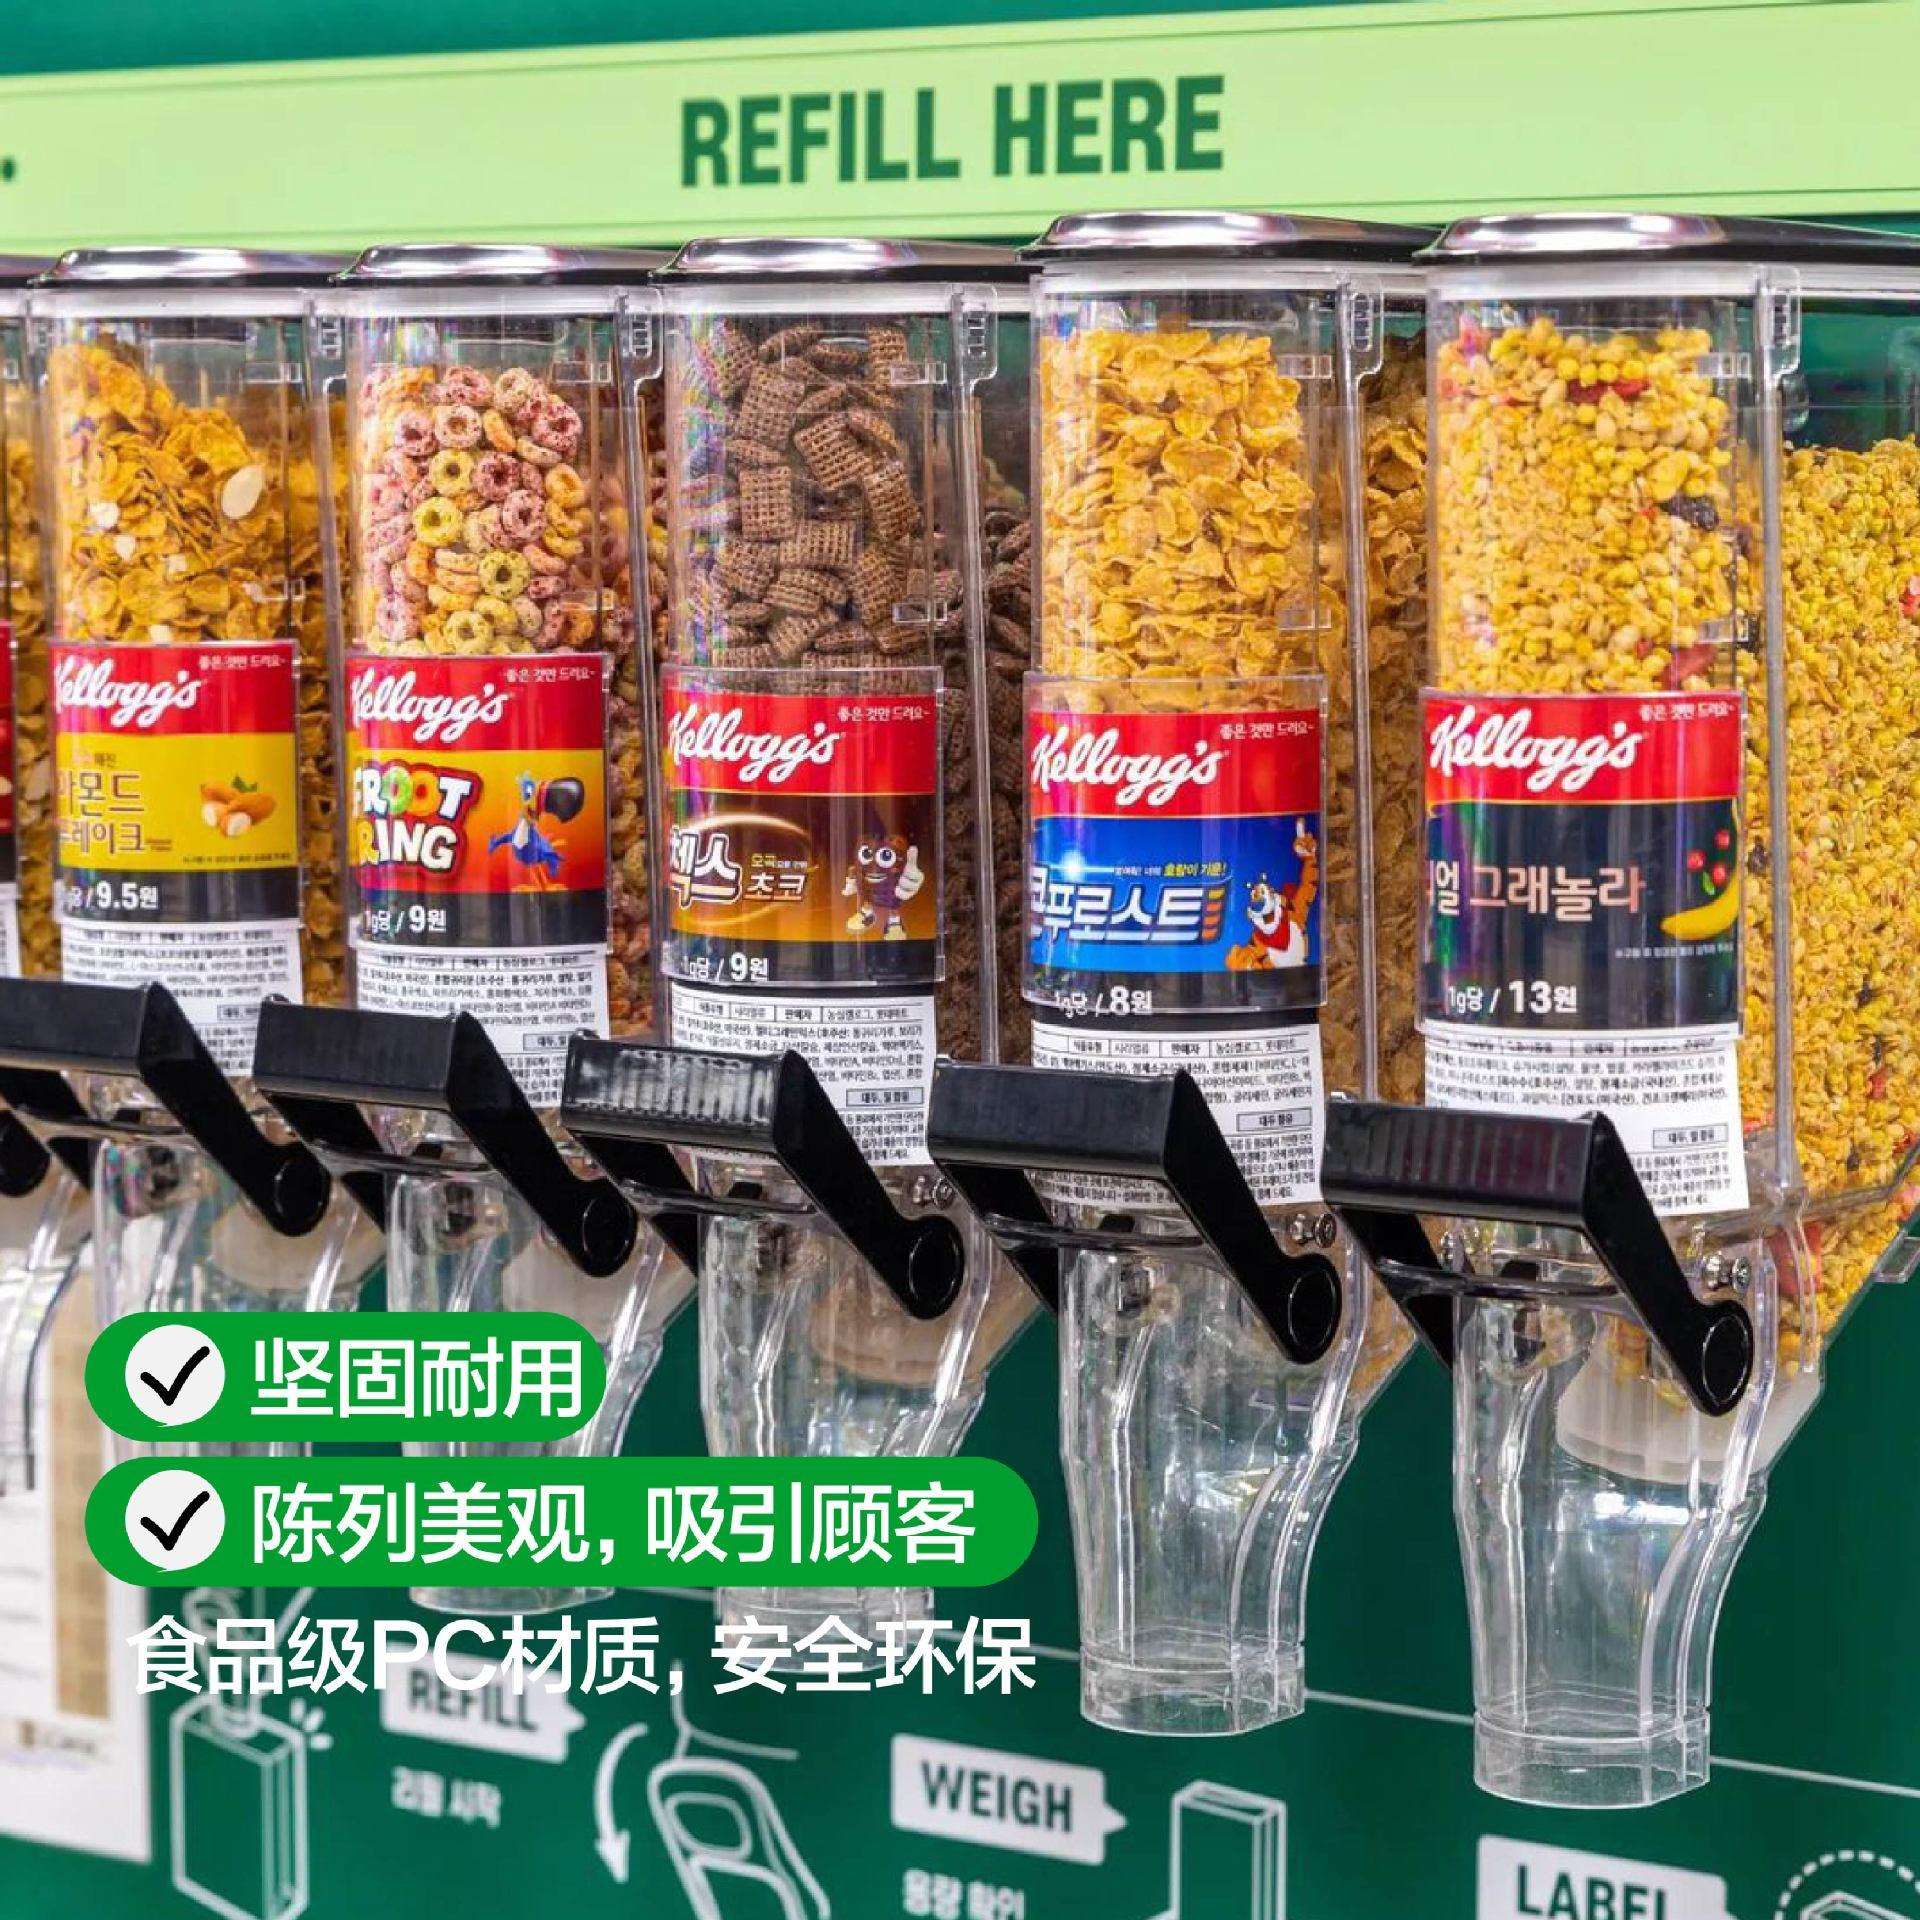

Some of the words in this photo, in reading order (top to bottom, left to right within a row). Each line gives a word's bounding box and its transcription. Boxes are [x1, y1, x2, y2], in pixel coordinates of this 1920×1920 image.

[682, 88, 961, 188] REFILL
[994, 76, 1225, 178] HERE
[668, 703, 841, 784] Kellogg's
[1031, 726, 1226, 807] Kellogg's
[1430, 704, 1647, 793] Kellogg's
[357, 819, 458, 871] RING
[97, 880, 158, 910] 9.5원
[743, 872, 806, 901] 초코
[1469, 861, 1648, 923] 그래놀라
[408, 905, 447, 933] 9원
[730, 952, 770, 982] 9원
[1109, 985, 1153, 1017] 8원
[1449, 984, 1484, 1014] 1g당
[1508, 980, 1579, 1015] 13원
[920, 1759, 1073, 1834] WEIGH
[1516, 1863, 1667, 1920] LABEL
